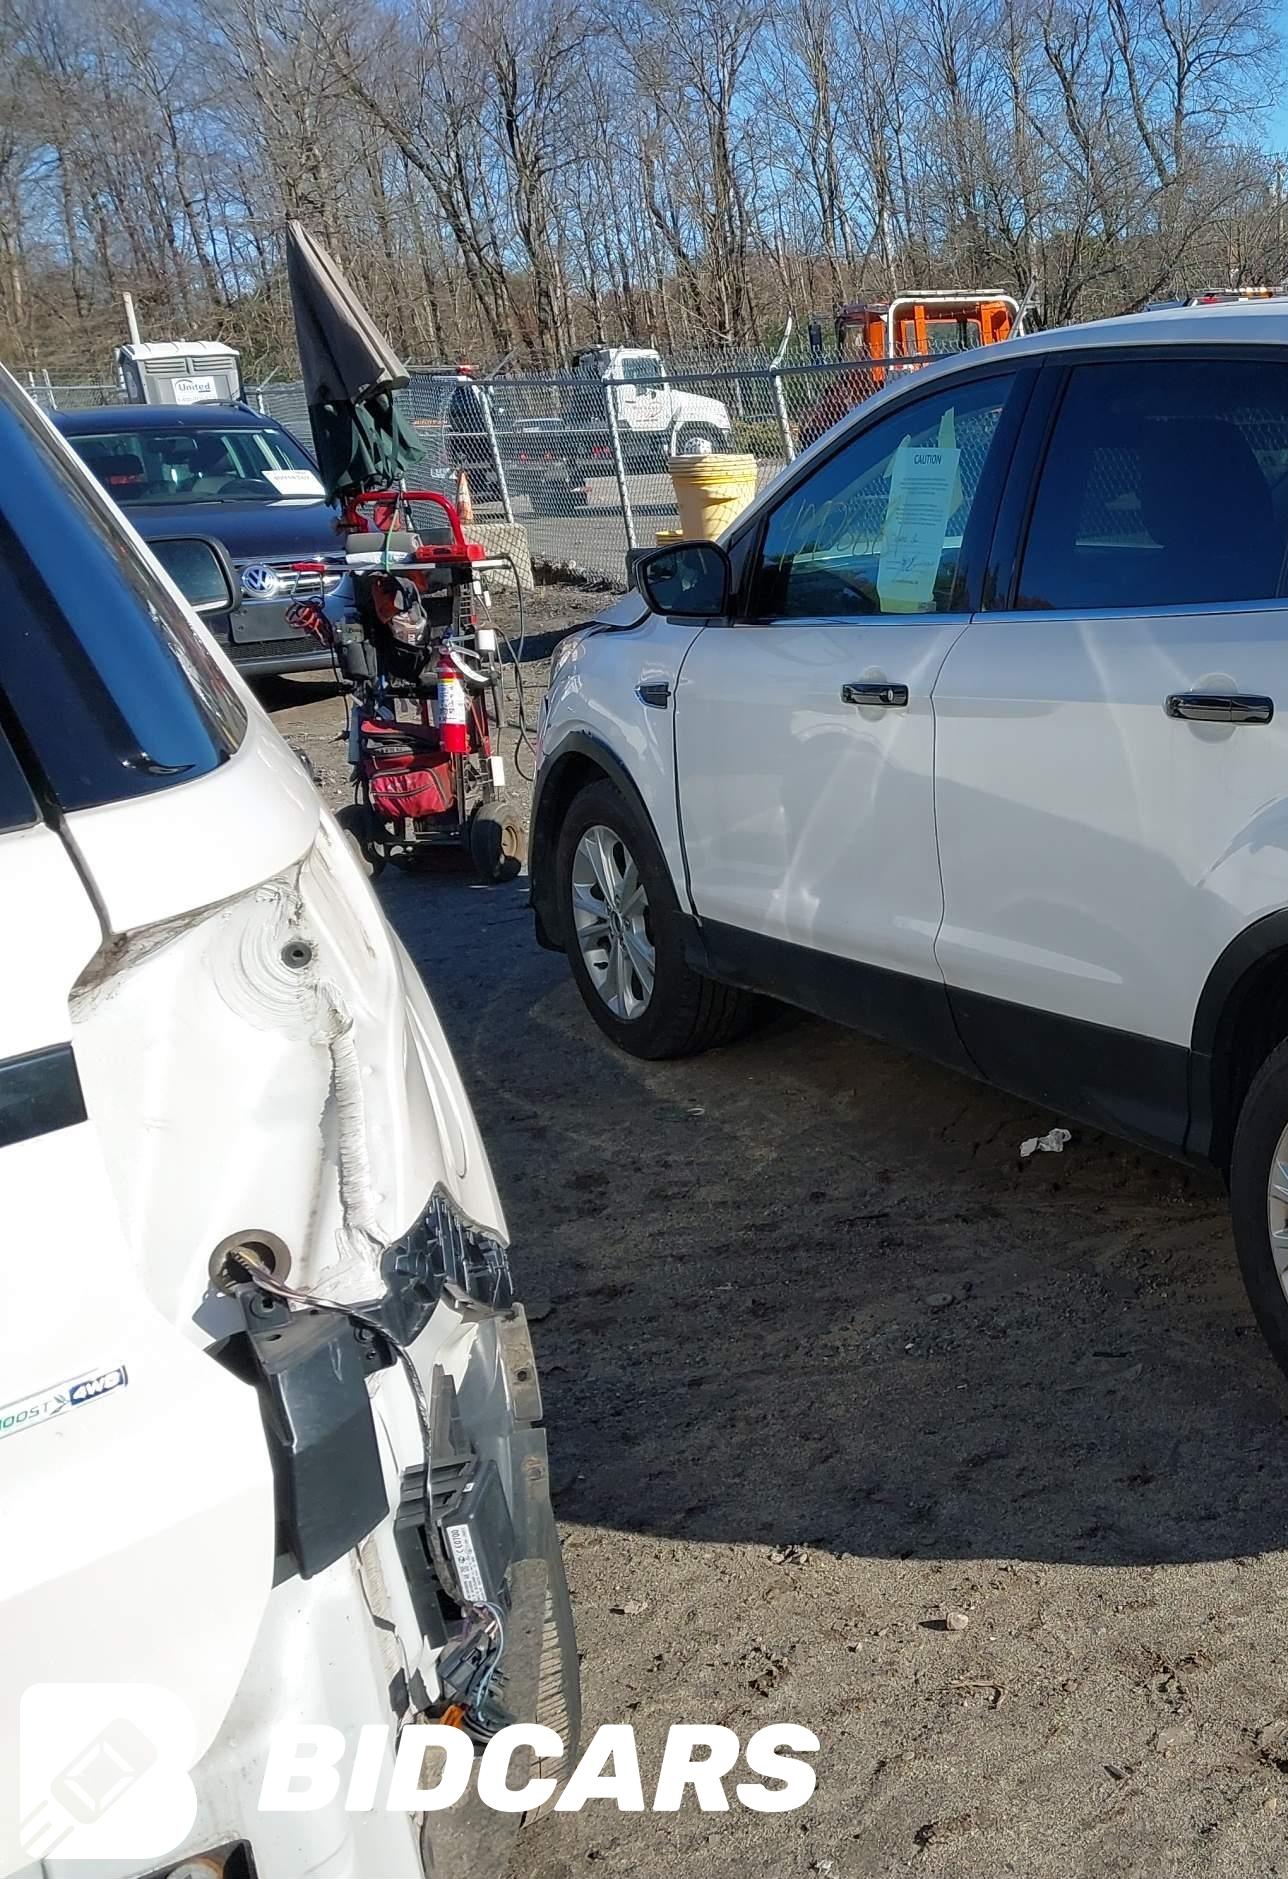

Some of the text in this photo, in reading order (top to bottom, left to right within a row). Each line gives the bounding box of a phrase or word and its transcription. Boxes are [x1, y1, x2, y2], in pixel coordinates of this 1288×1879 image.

[178, 382, 211, 391] United
[914, 454, 942, 465] CAUTION
[243, 566, 275, 594] VW
[0, 1370, 120, 1430] OOST 4WD
